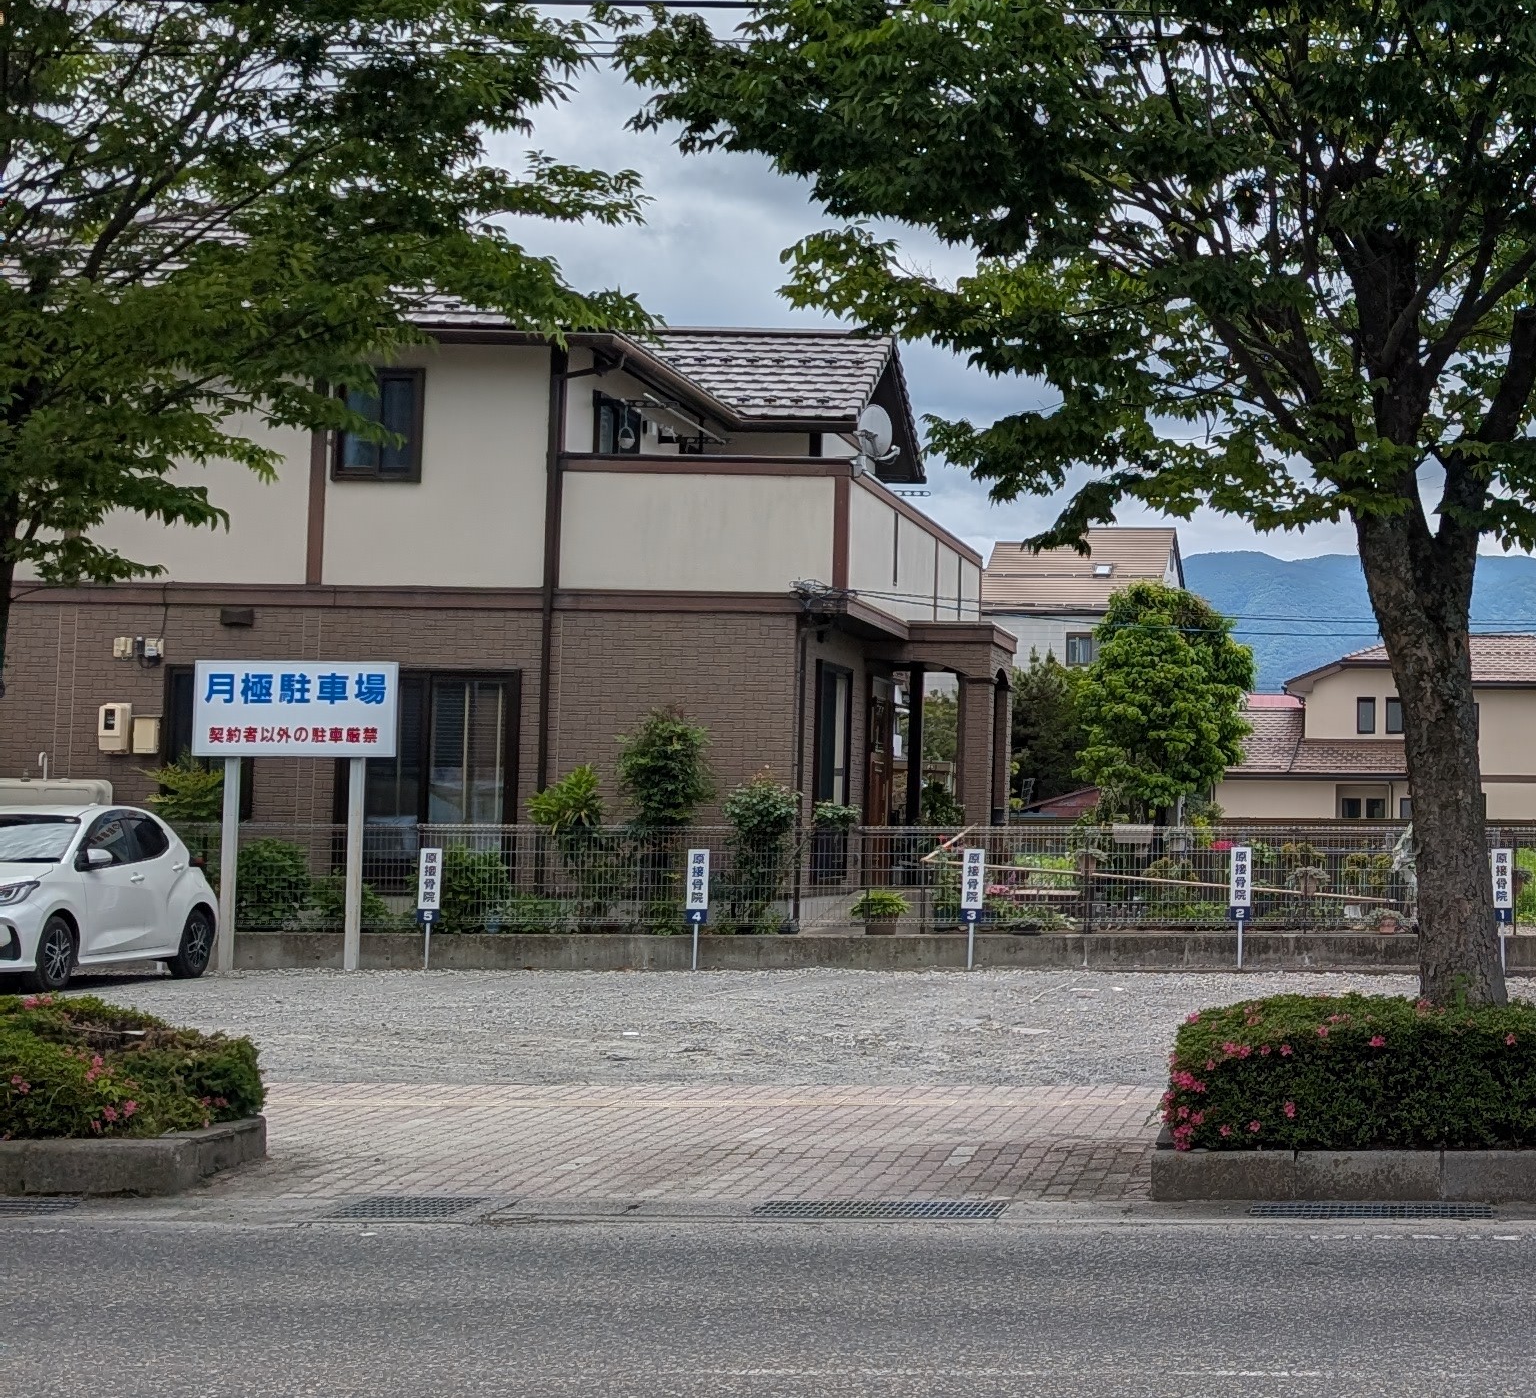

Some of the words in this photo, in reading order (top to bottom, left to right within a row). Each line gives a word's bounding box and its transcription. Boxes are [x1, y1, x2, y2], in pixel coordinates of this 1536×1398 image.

[204, 672, 387, 705] 月極駐車場
[208, 726, 379, 744] 契約者以外の駐車厳禁
[423, 852, 437, 903] 原接骨院
[691, 853, 705, 904] 原接骨院
[966, 852, 981, 903] 原接骨院
[1235, 851, 1247, 901] 原接骨院
[1496, 852, 1508, 902] 原接骨院
[423, 911, 433, 921] 5
[691, 911, 702, 922] 4
[967, 911, 976, 920] 3
[1236, 909, 1245, 918] 2
